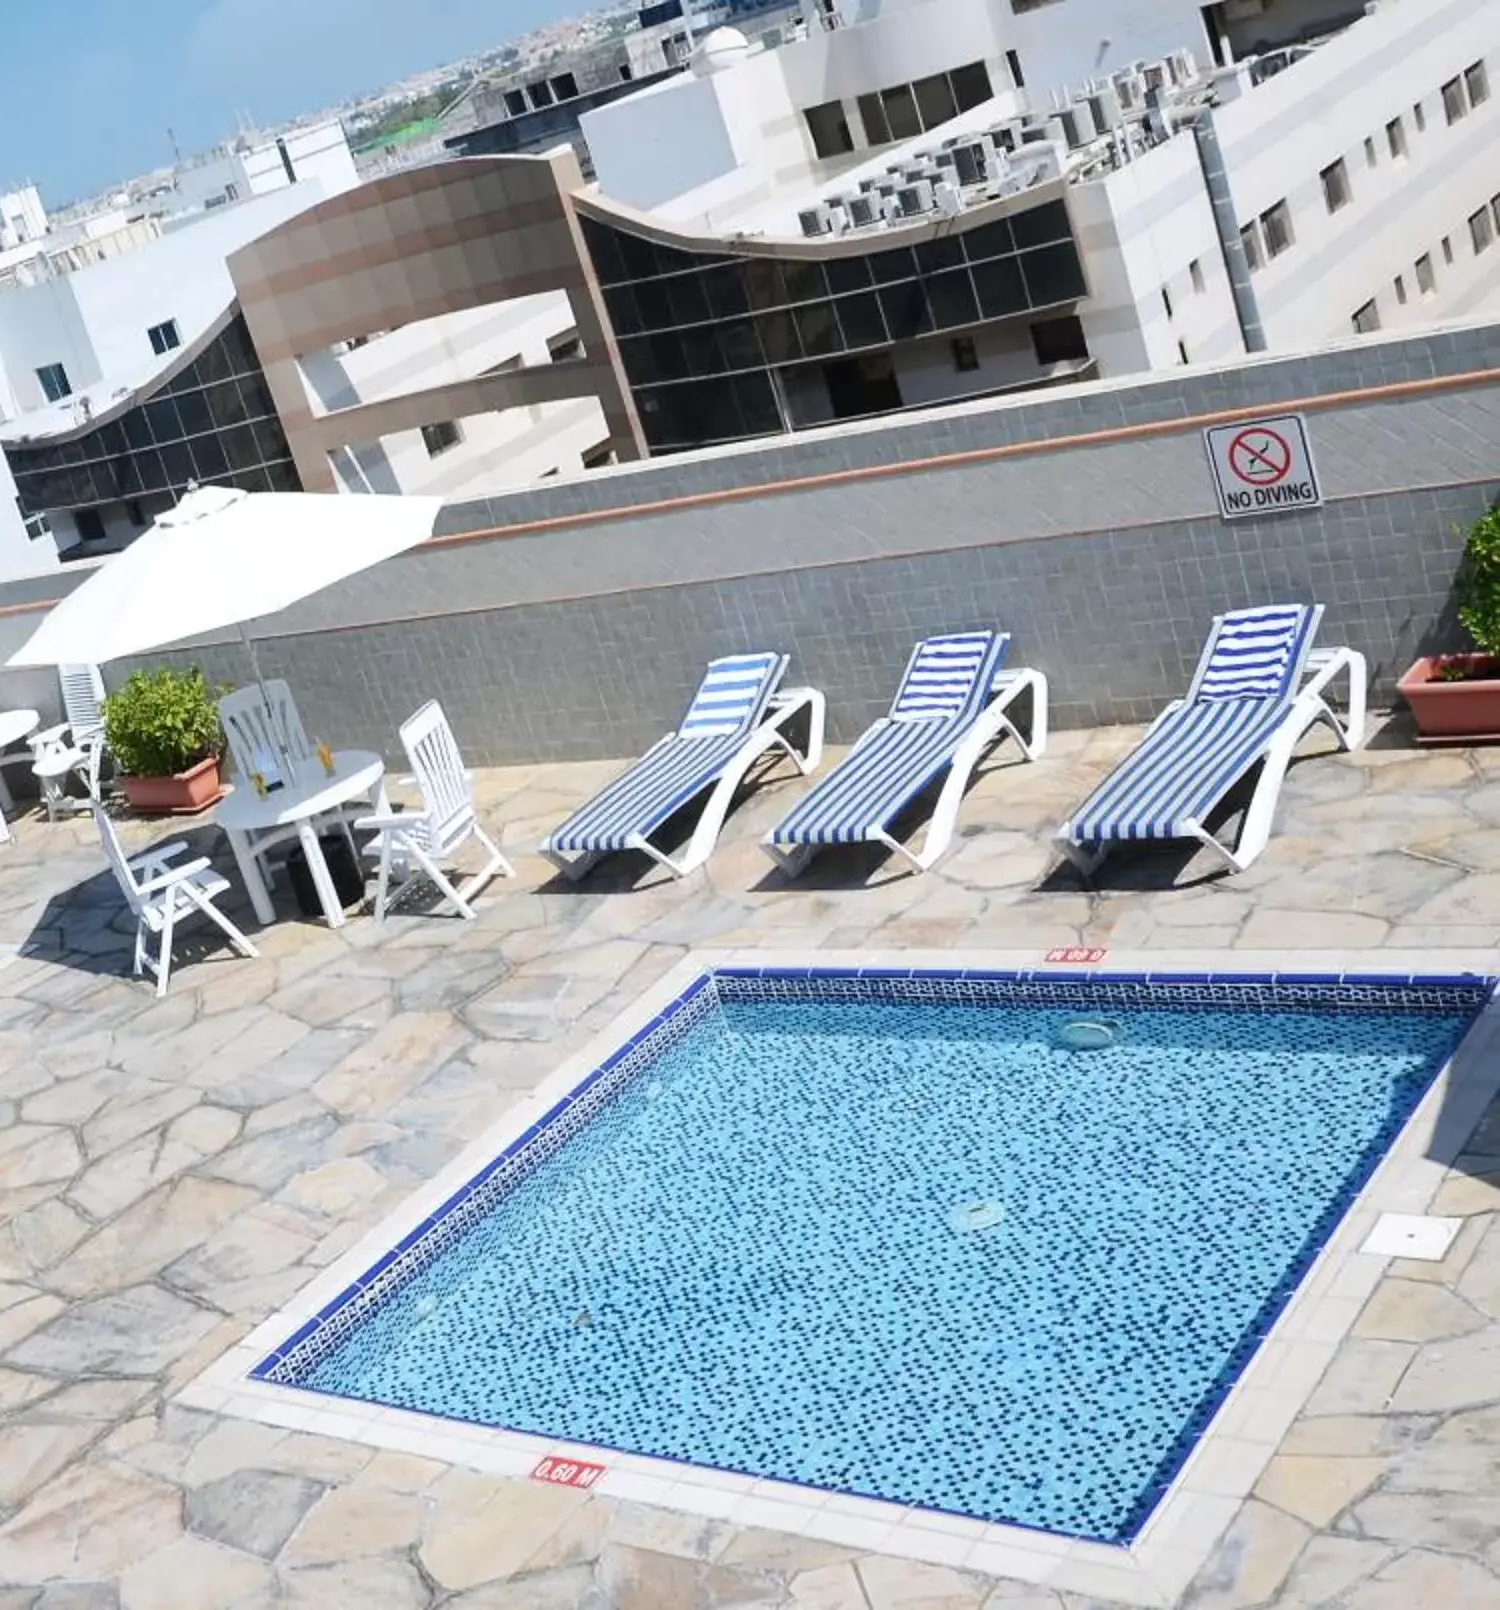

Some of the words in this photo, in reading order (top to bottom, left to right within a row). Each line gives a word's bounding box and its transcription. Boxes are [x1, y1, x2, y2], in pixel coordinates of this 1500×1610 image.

[1228, 492, 1250, 509] NO
[1254, 482, 1312, 506] DIVING
[574, 1467, 599, 1487] M
